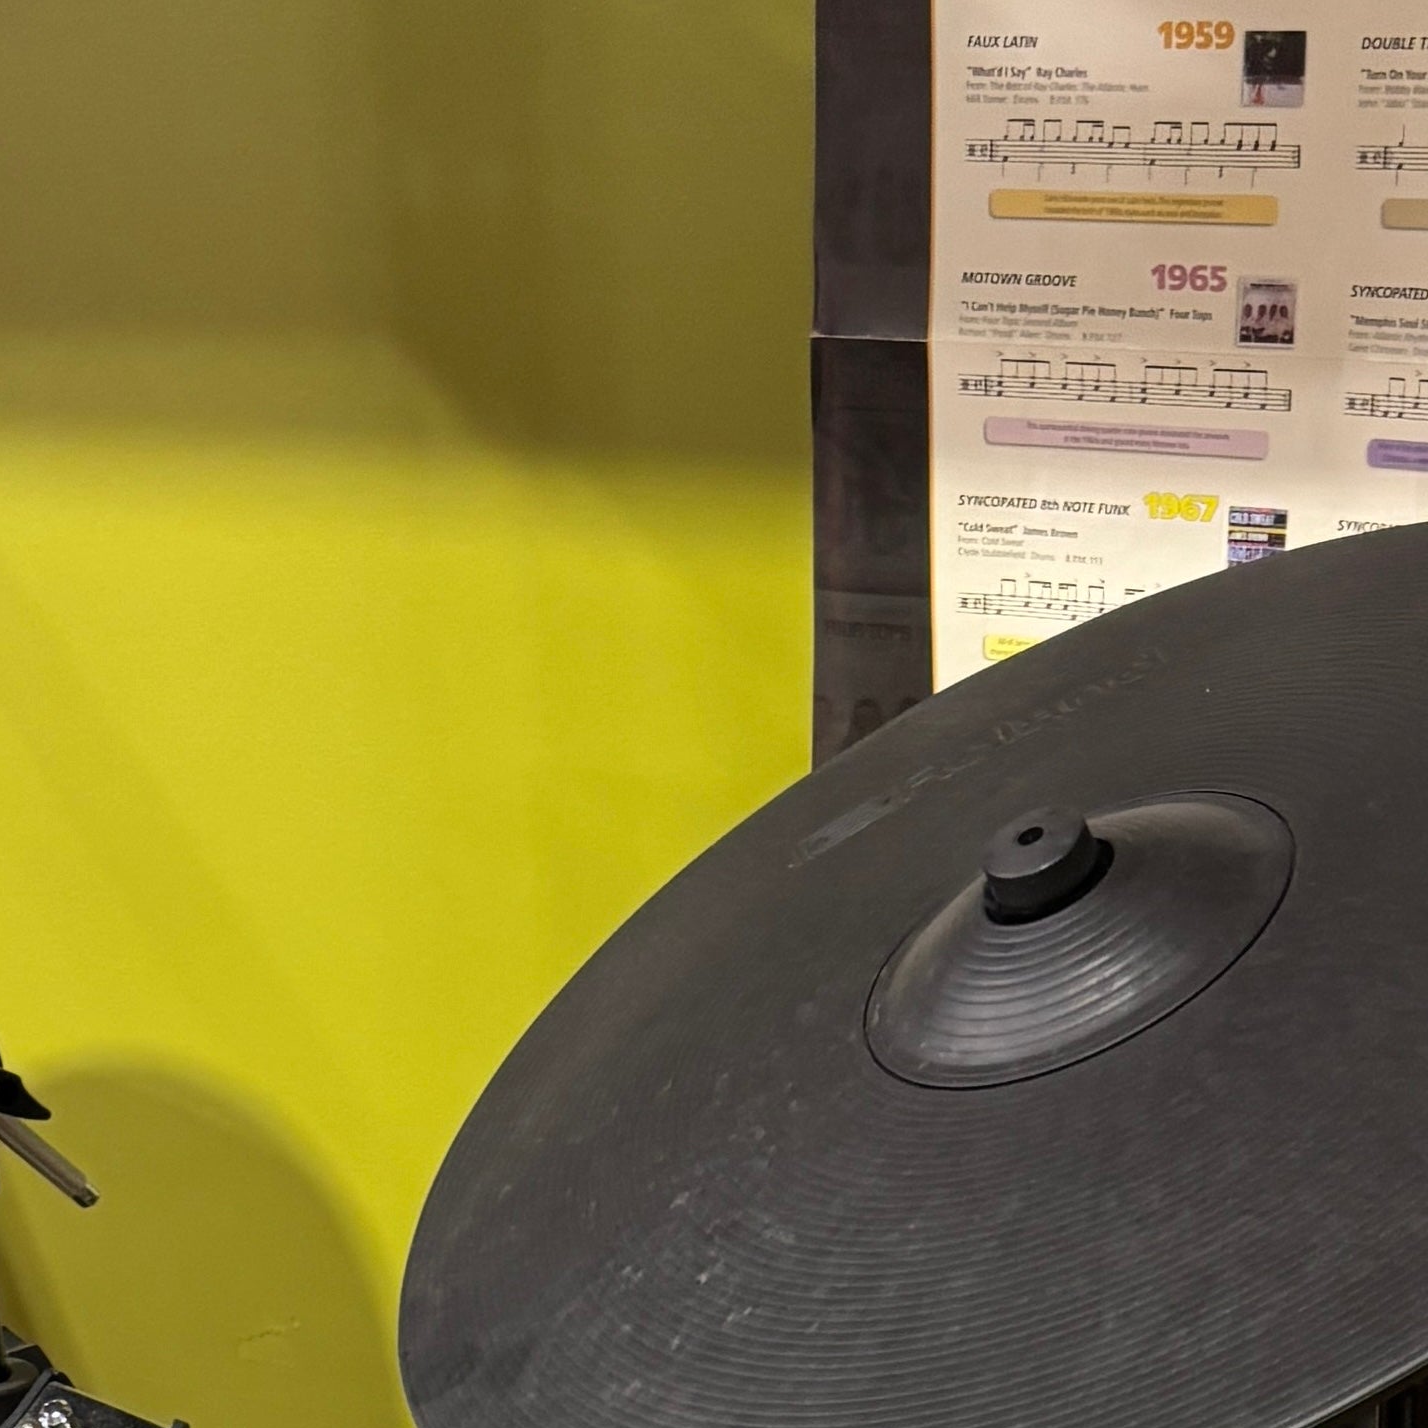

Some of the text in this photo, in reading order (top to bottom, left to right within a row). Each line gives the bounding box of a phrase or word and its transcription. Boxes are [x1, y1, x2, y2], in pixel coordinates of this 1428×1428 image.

[967, 35, 1039, 50] FAUX LATIN
[1157, 21, 1235, 50] 1959
[1361, 37, 1418, 51] DOUBLE
[961, 271, 1077, 287] MOTOWN GROOVE
[1151, 264, 1227, 292] 1965
[1350, 285, 1428, 300] SYNCOPATED
[957, 494, 1037, 511] SYNCOPATED
[1063, 500, 1095, 514] NOTE
[1098, 502, 1131, 516] FUNK
[1143, 491, 1220, 523] 1967
